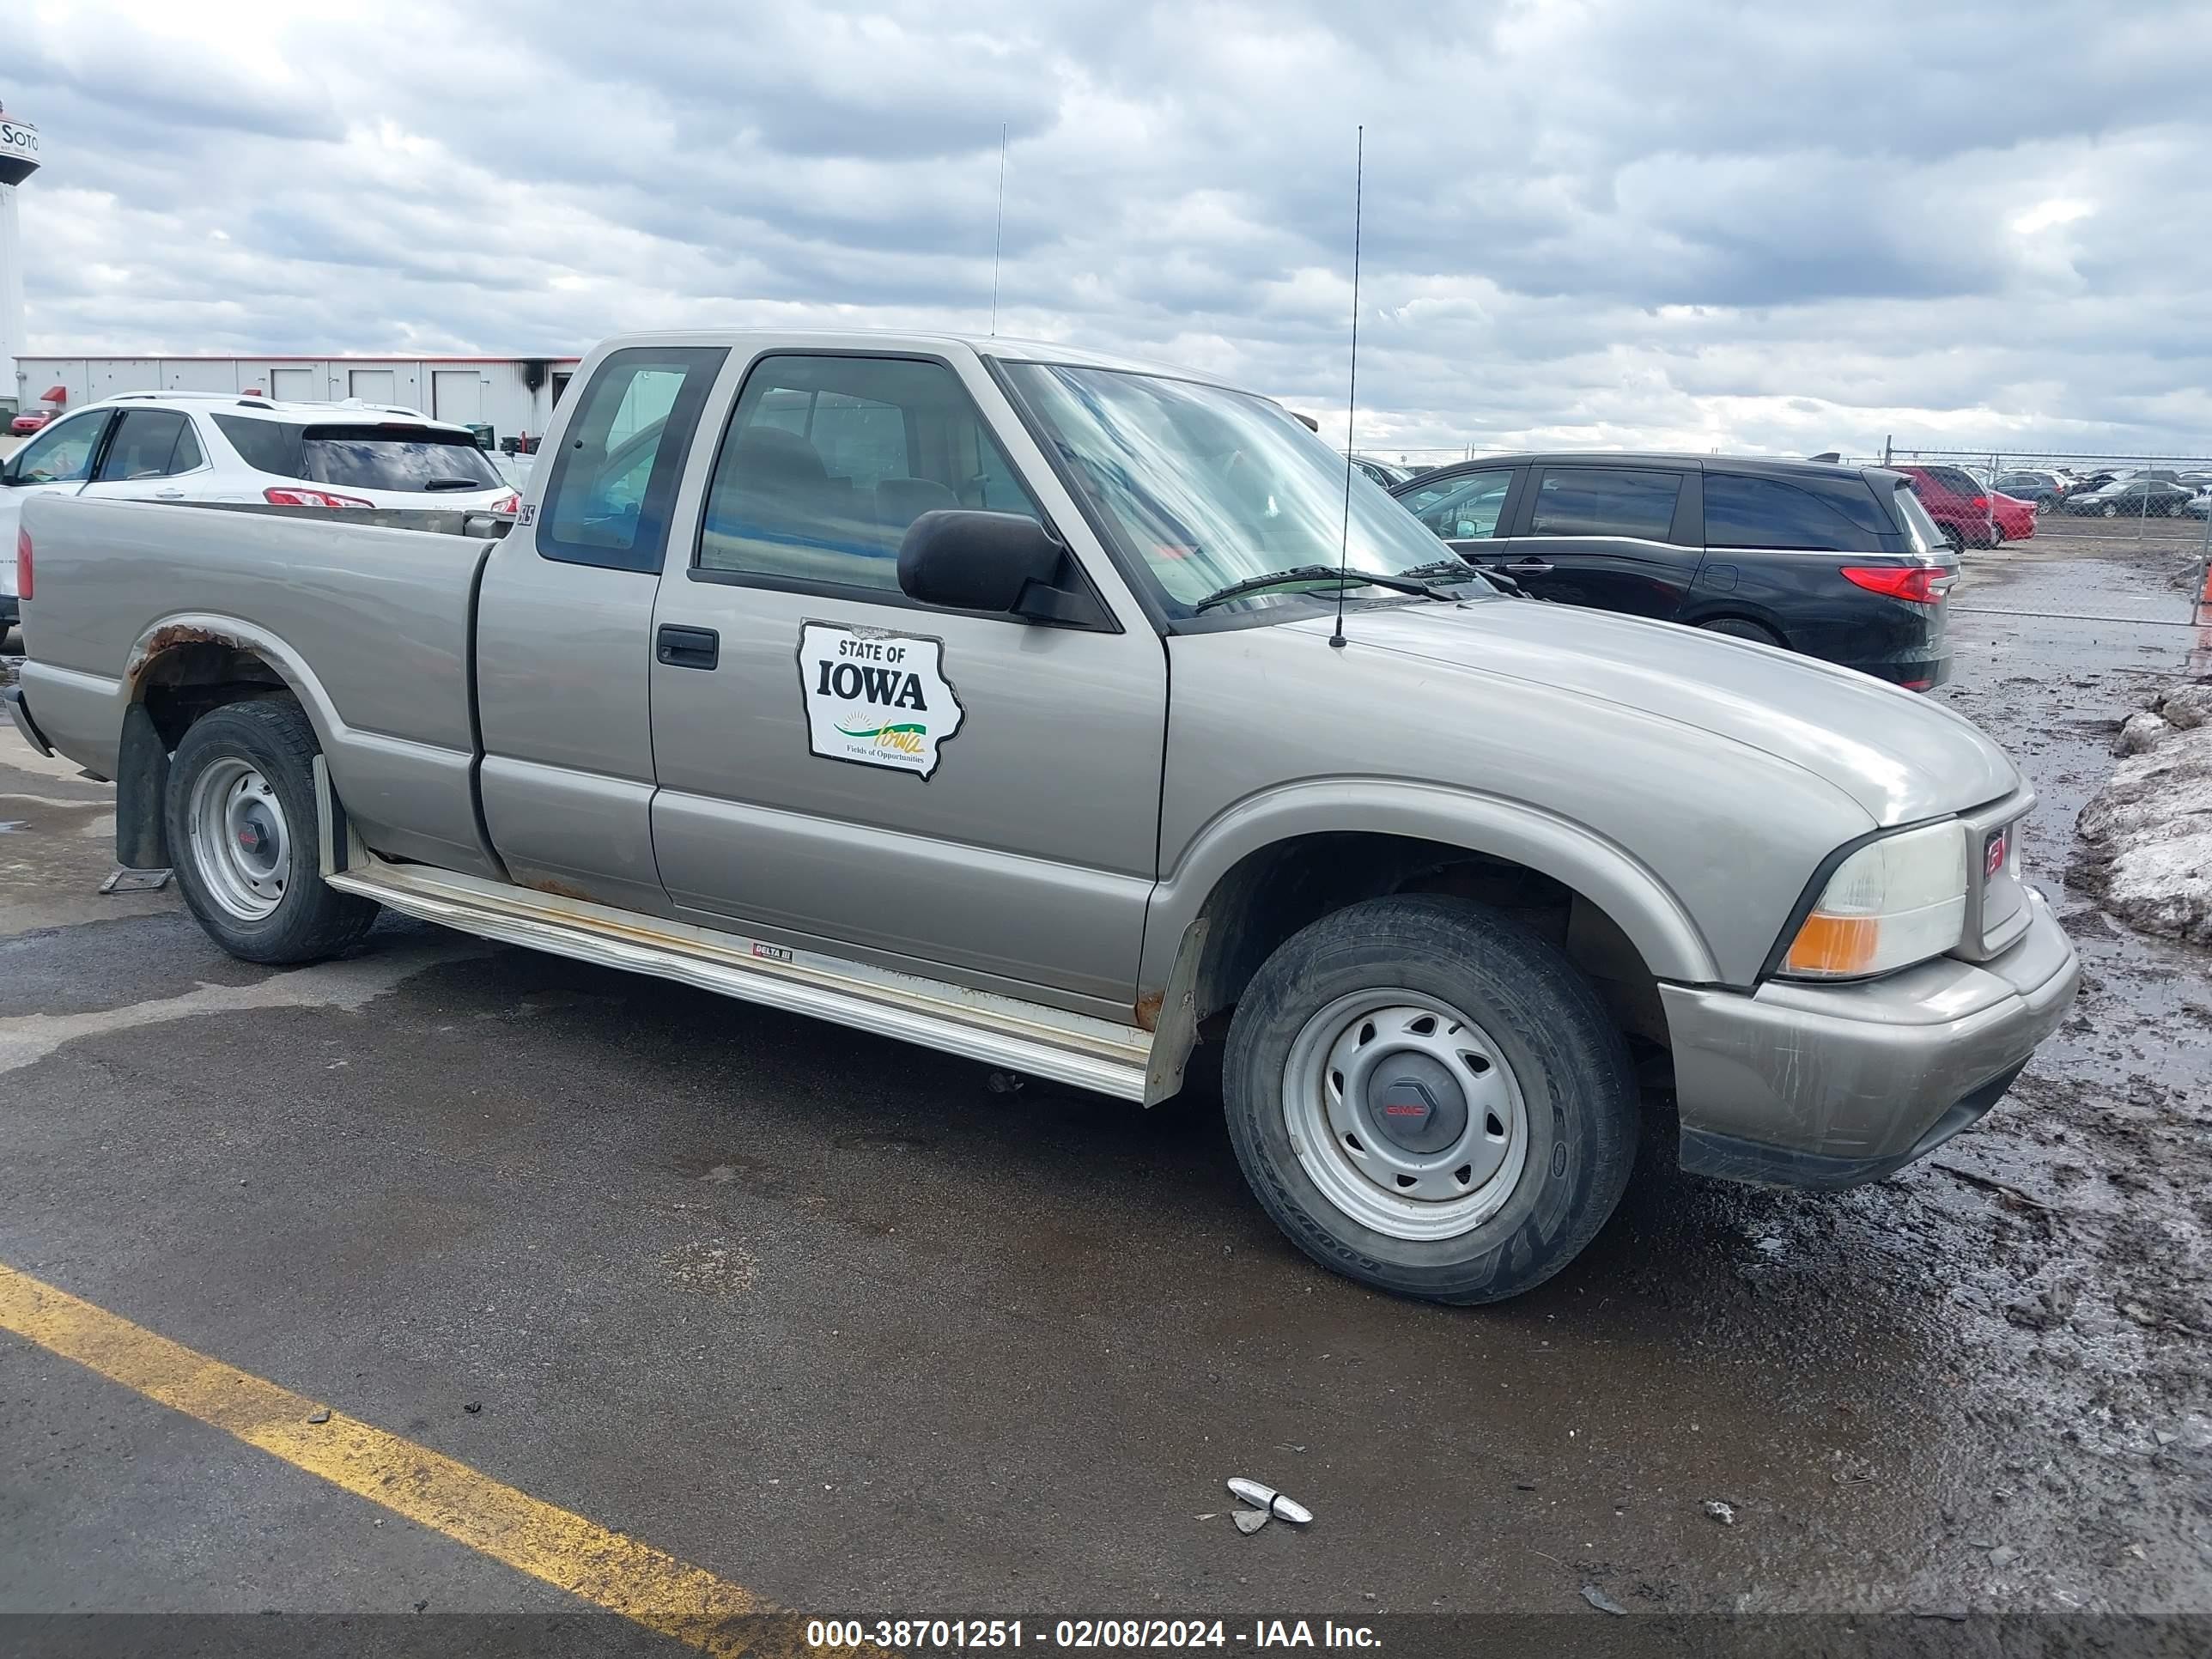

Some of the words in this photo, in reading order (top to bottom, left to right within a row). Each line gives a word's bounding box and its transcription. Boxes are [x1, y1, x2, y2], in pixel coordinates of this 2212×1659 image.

[2, 124, 39, 151] SOTO
[839, 639, 883, 660] STATE
[886, 646, 906, 664] OF
[817, 659, 928, 712] IOWA
[874, 718, 926, 754] Iowa
[847, 744, 867, 755] Fields
[877, 750, 925, 763] Opportunities
[756, 945, 781, 957] DELTA
[1386, 1105, 1425, 1116] GMC
